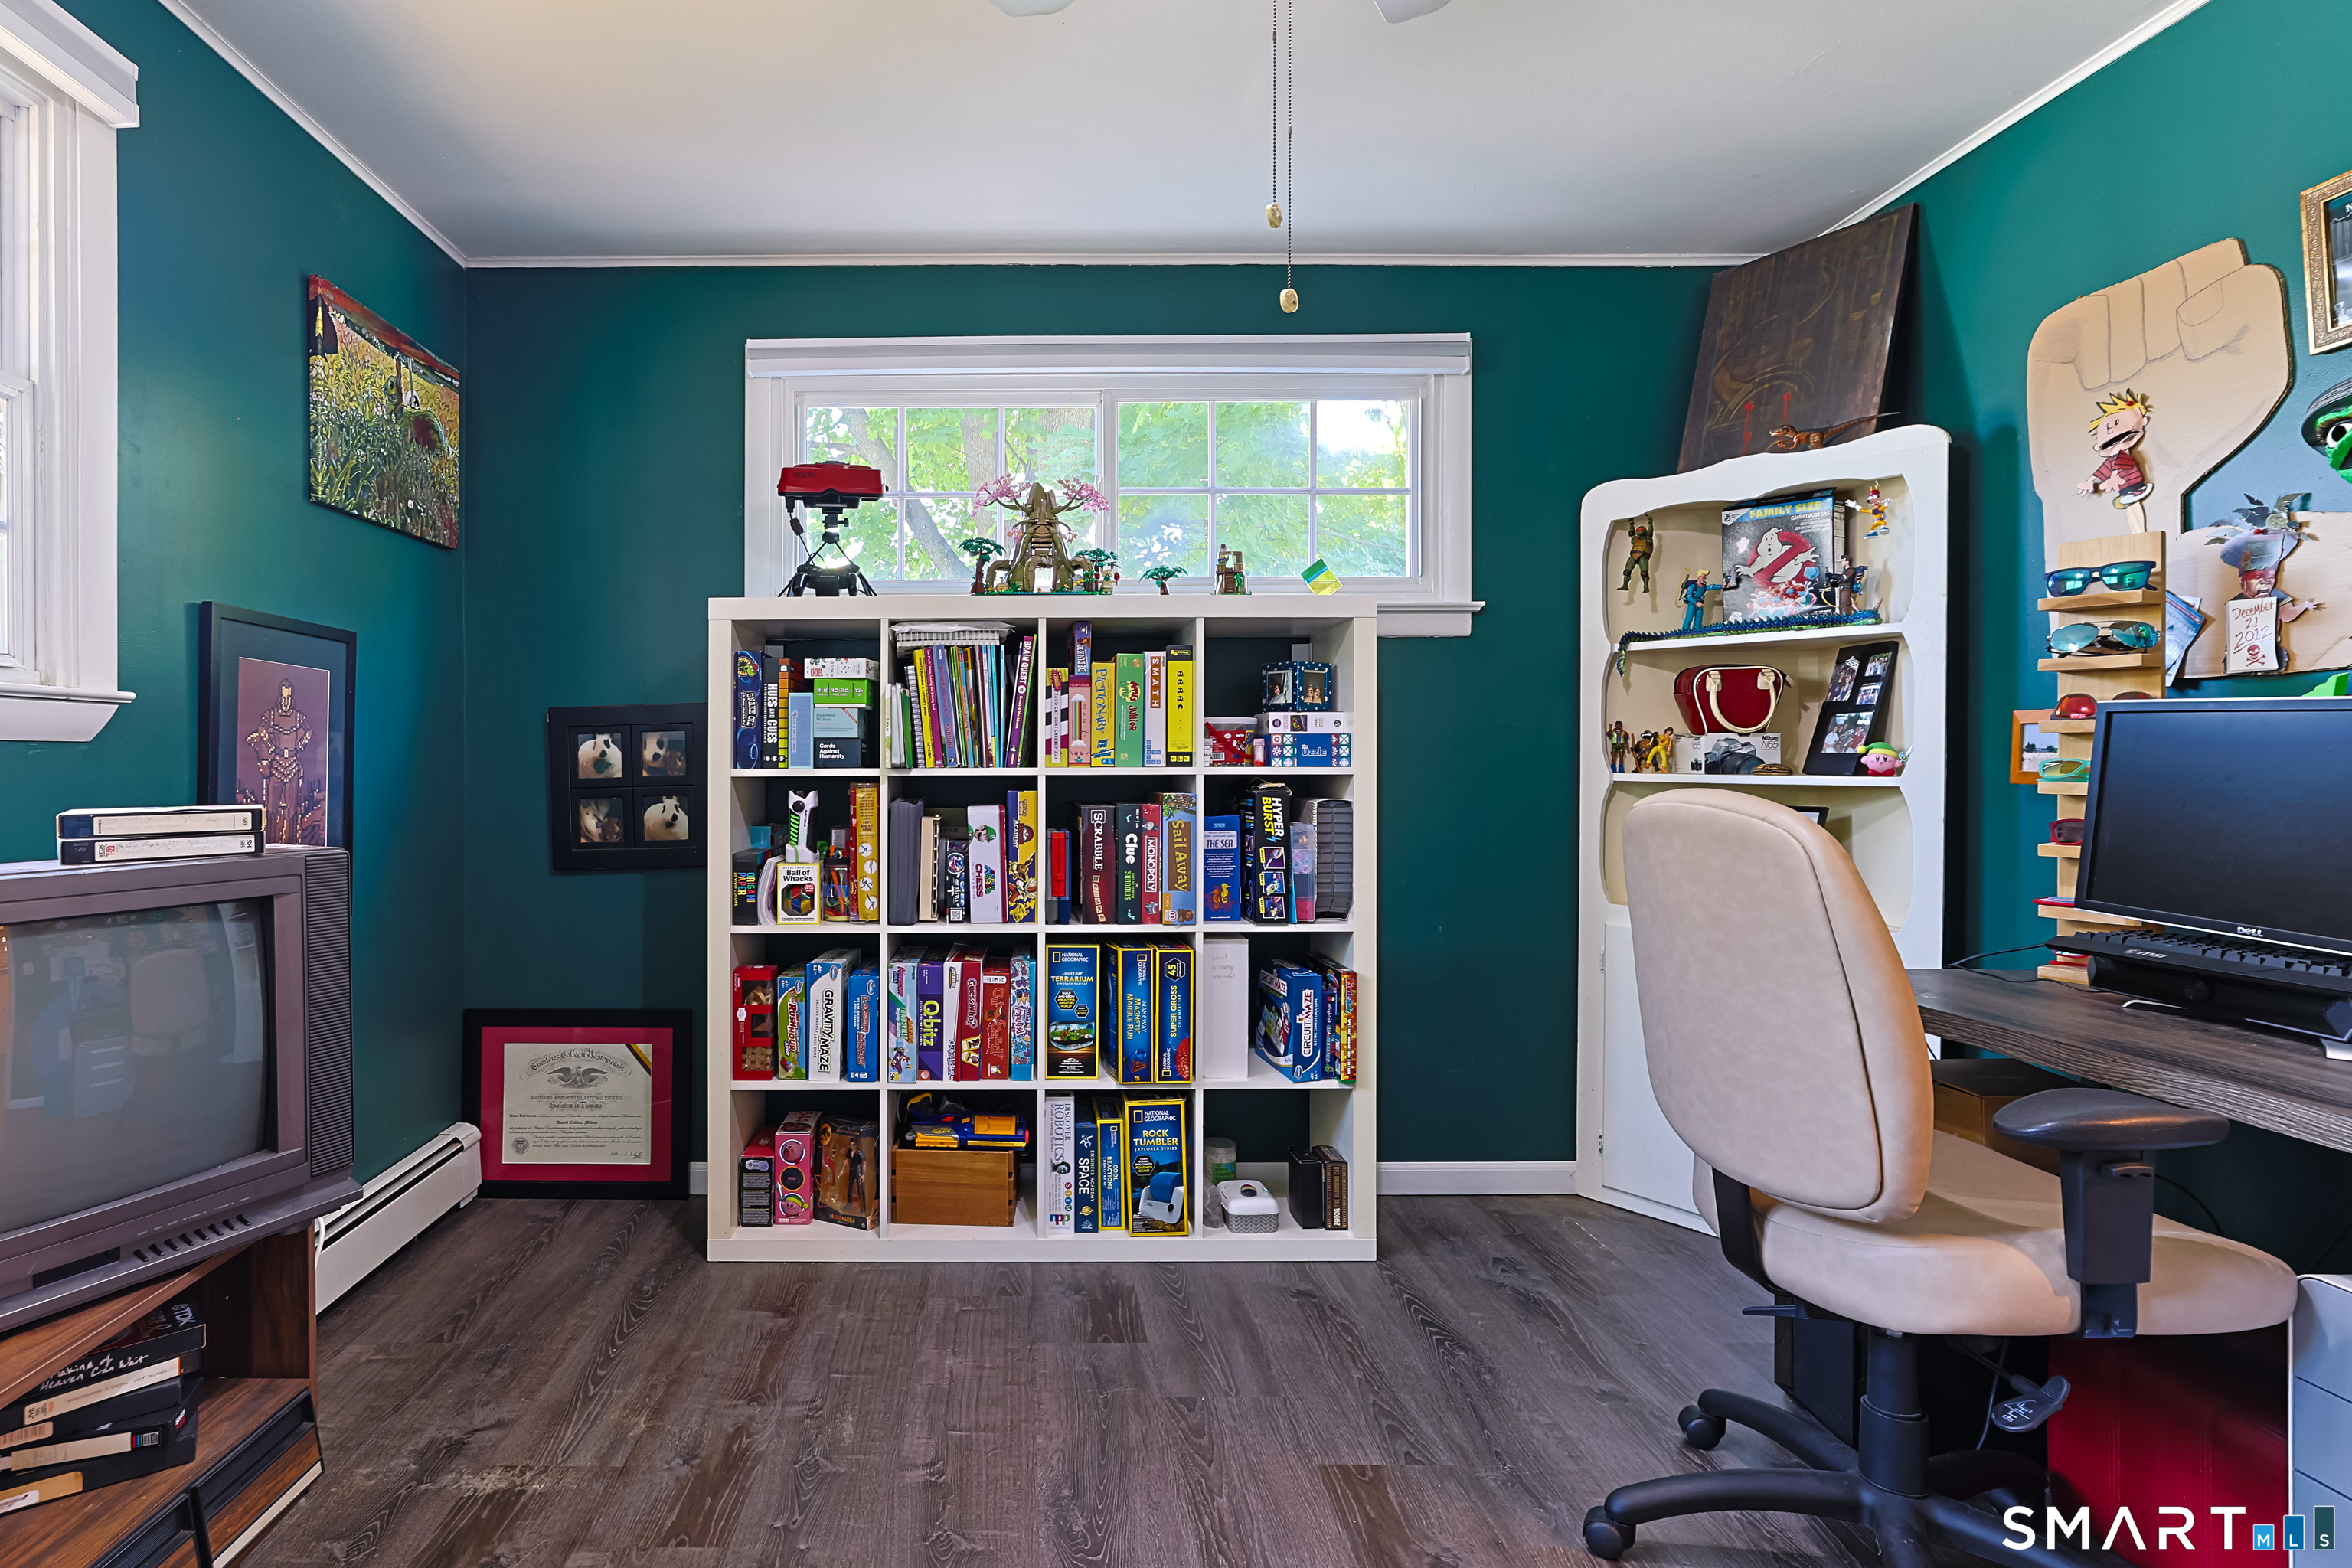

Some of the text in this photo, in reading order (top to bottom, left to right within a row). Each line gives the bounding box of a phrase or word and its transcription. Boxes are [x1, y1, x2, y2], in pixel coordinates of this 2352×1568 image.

[1749, 505, 1793, 518] FAMILY
[1795, 501, 1822, 513] SIZE
[2234, 626, 2272, 651] 2012
[2245, 617, 2259, 629] 21
[1019, 641, 1032, 684] BRAIN QUEST
[767, 683, 778, 707] HUES
[1095, 668, 1108, 734] PICTIONARY
[1130, 681, 1140, 702] APPLES
[747, 692, 756, 727] SNAKE OIL
[767, 720, 778, 743] CUES
[1761, 740, 1779, 749] N65
[1302, 747, 1327, 756] Uzzle
[1262, 796, 1274, 835] BURST
[1271, 797, 1285, 836] HYPER
[1093, 812, 1103, 870] SCRABBLE
[1125, 833, 1138, 864] Clue
[1171, 819, 1188, 893] Sail Away
[1207, 839, 1233, 848] THE SEA
[1147, 839, 1155, 890] MONOPOLY
[738, 872, 746, 896] PAPER
[746, 872, 756, 903] ORIGAMI
[975, 864, 984, 897] CHESS
[1092, 875, 1106, 922] DELUXE
[2237, 926, 2263, 937] DELL
[897, 966, 906, 998] POWERPUFF
[1168, 964, 1176, 976] 45
[787, 1003, 798, 1051] RUSH HOUR
[819, 989, 835, 1072] GRAVITY MAZE
[966, 1003, 977, 1027] Who?
[991, 988, 1006, 1057] Out foxed!
[1303, 1021, 1312, 1055] CIRCUIT
[1055, 1103, 1064, 1161] ROBOTICS
[1133, 1138, 1179, 1146] TUMBLER
[1142, 1129, 1168, 1138] ROCK
[1078, 1158, 1089, 1194] SPACE
[1050, 1214, 1070, 1225] npp
[174, 1306, 196, 1326] TDK
[39, 1354, 149, 1392] Heaven Can Wait
